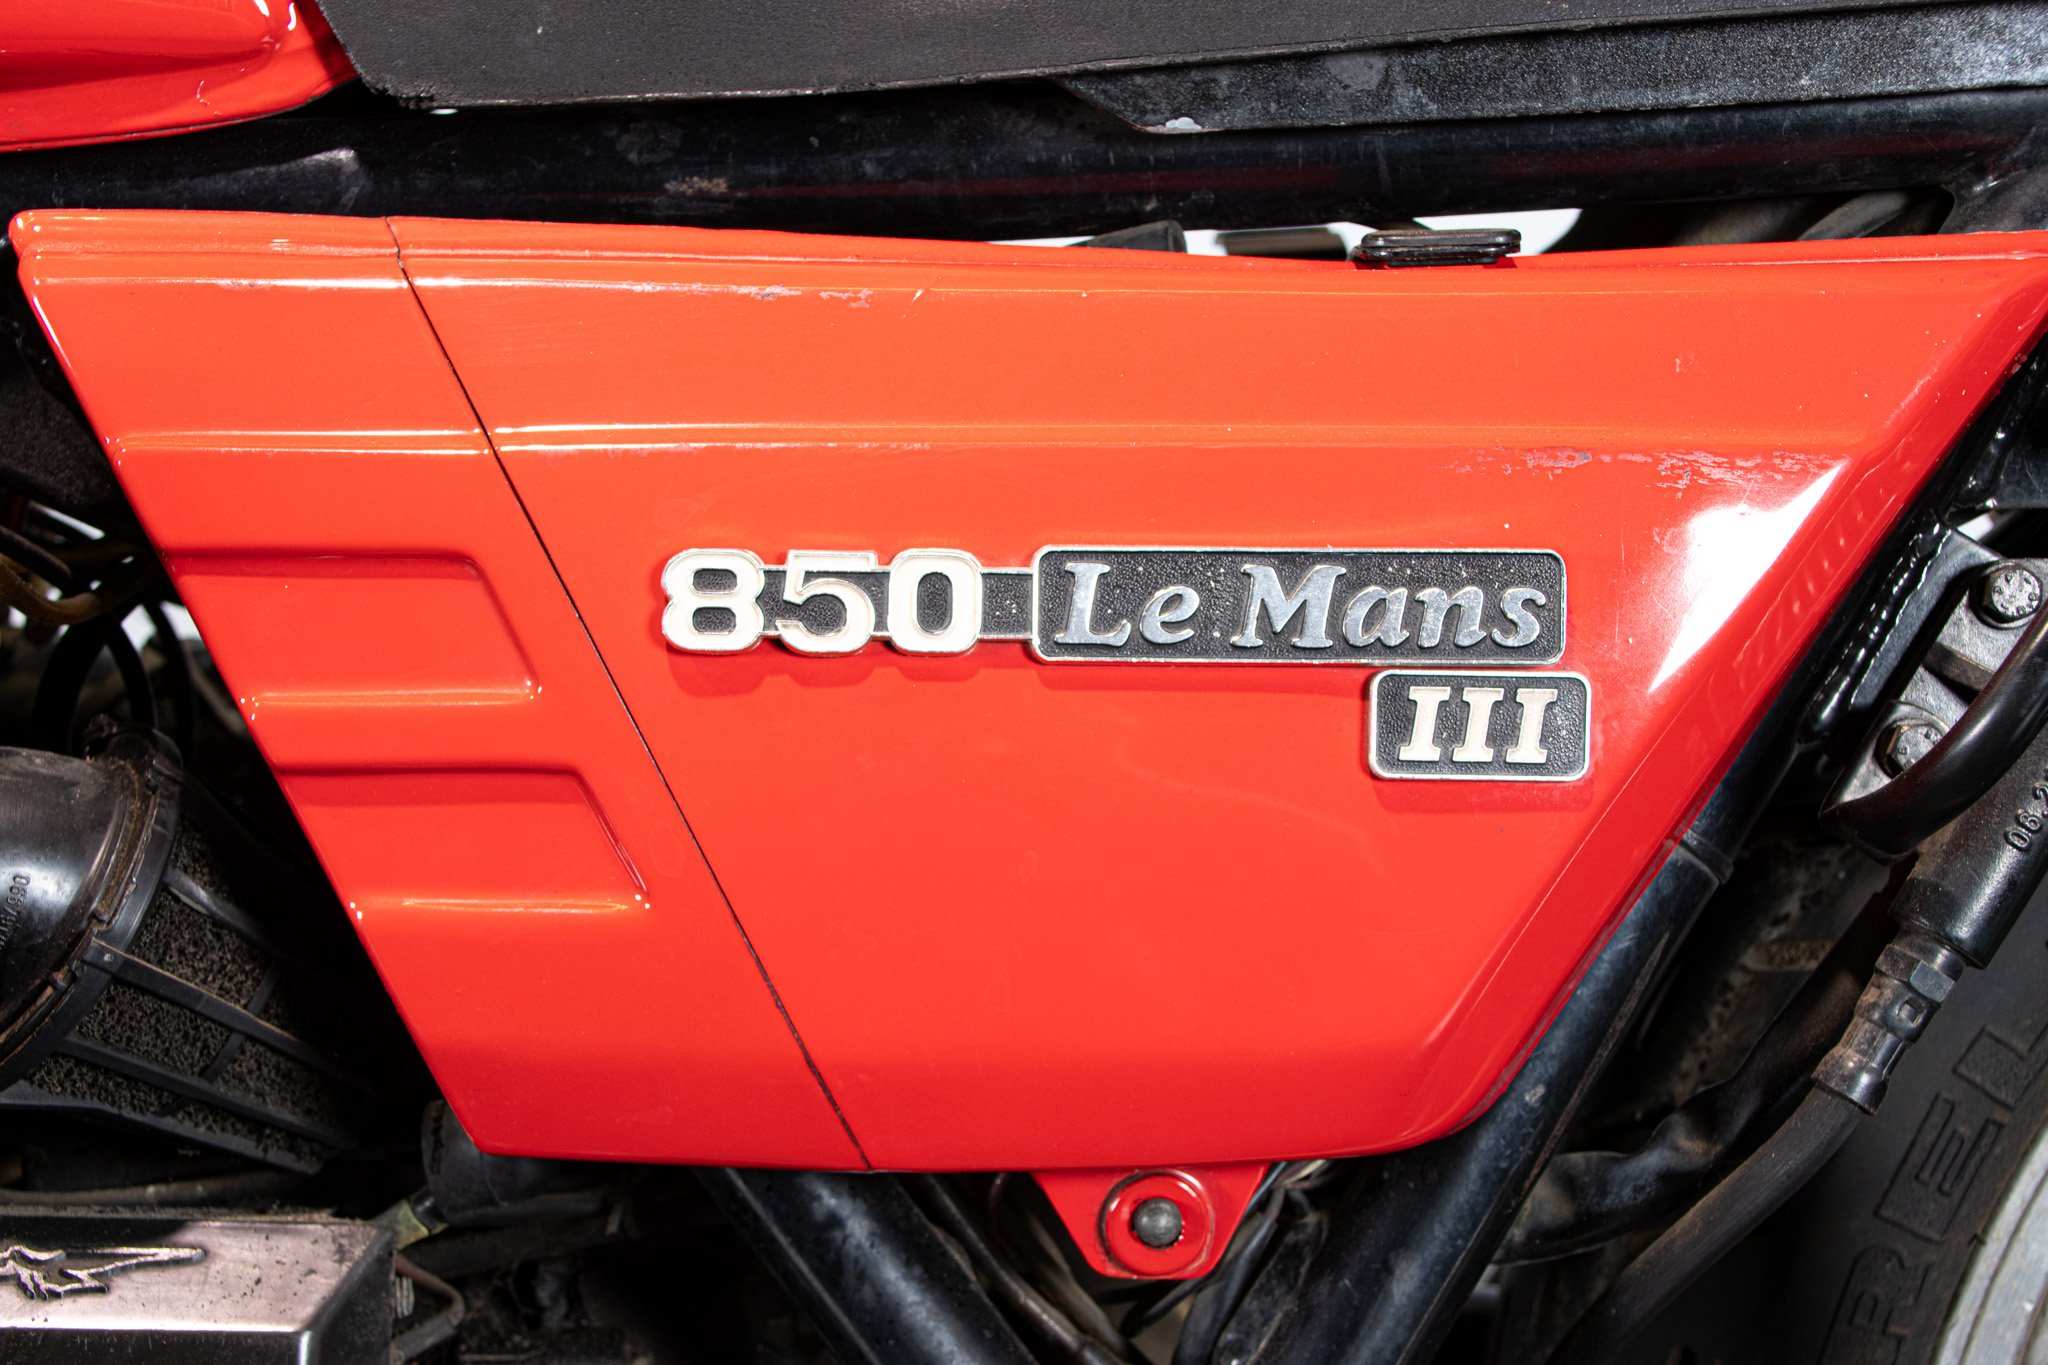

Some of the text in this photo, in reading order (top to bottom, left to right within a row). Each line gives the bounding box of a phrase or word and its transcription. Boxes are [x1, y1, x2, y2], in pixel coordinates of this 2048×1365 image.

[661, 548, 1550, 656] 850 Le Mans
[1398, 686, 1558, 764] III
